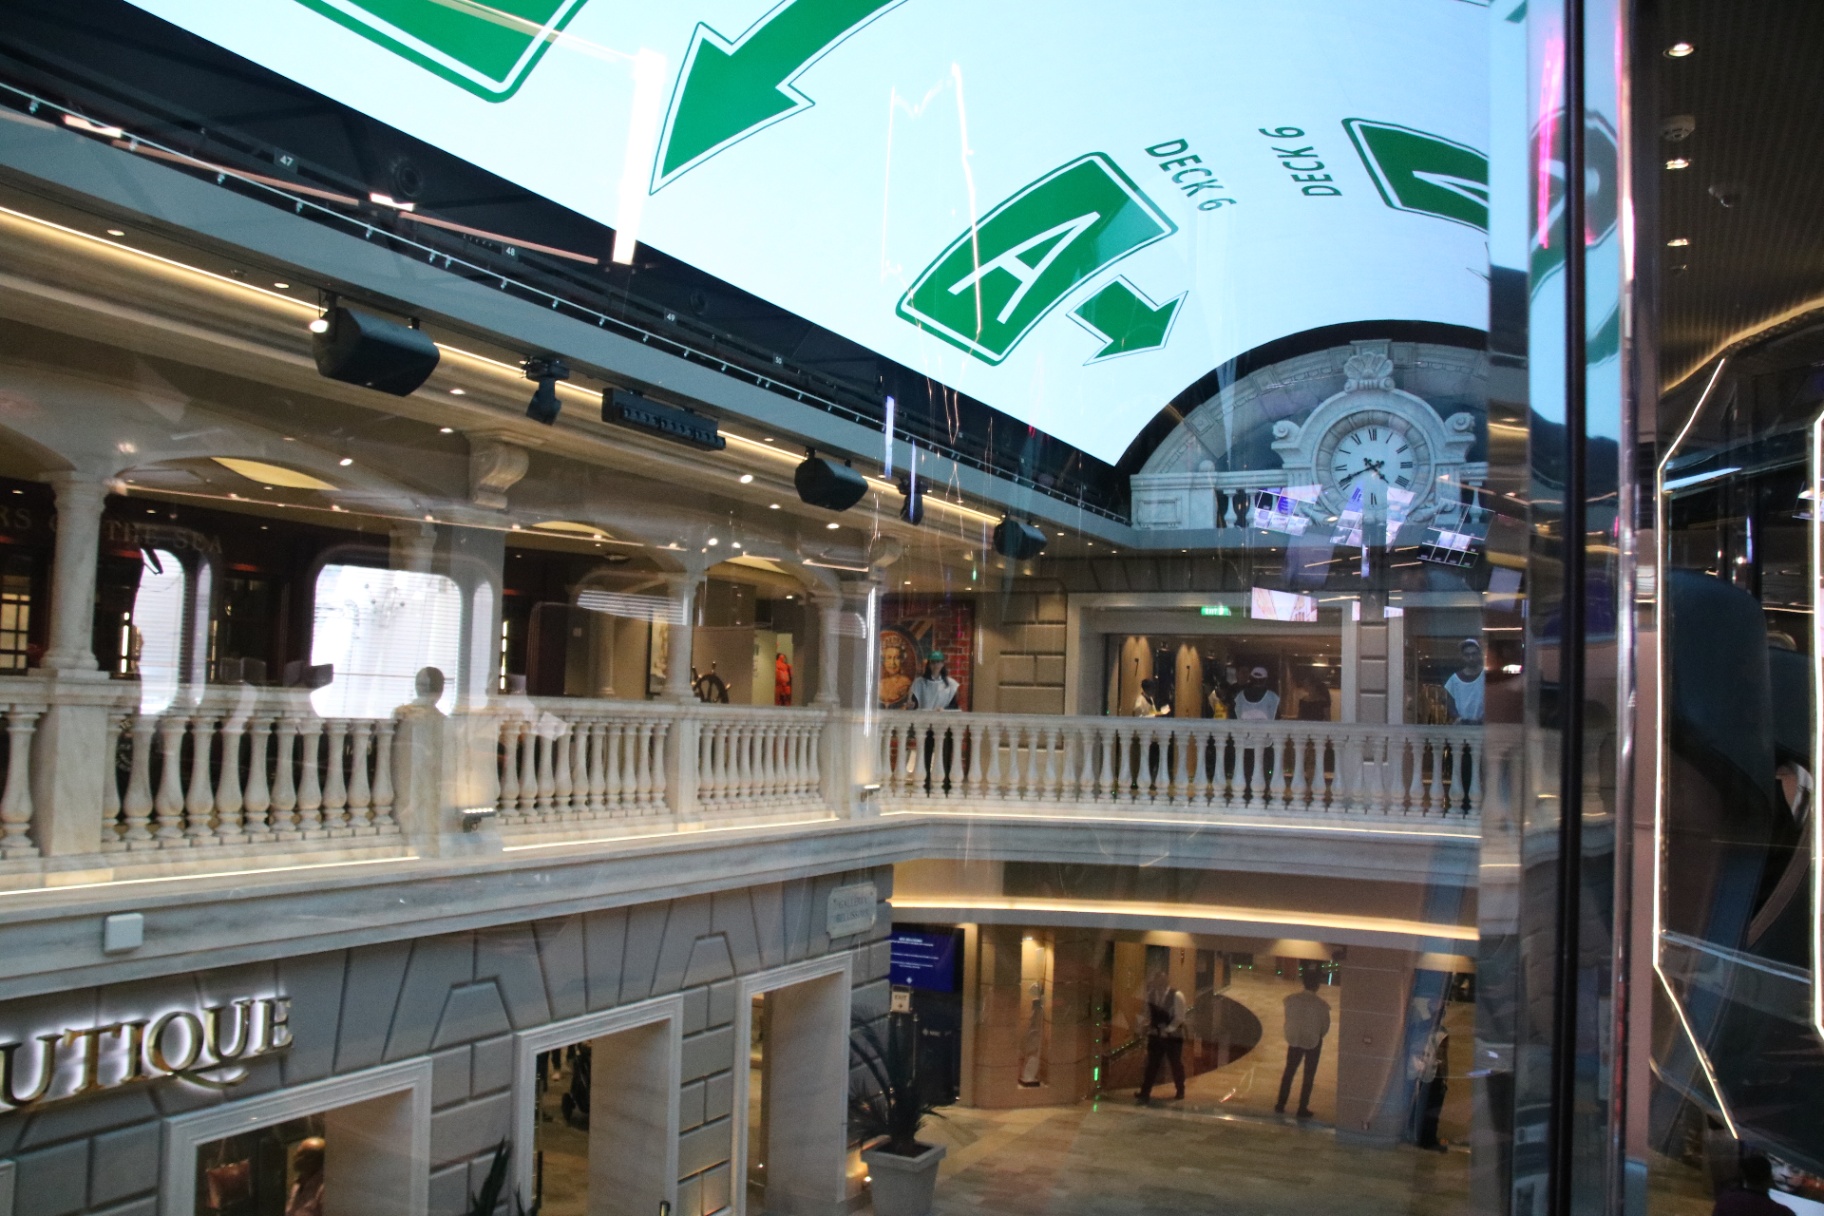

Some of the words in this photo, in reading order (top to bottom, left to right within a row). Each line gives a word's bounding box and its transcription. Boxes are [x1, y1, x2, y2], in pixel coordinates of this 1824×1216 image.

[1258, 127, 1305, 138] 6
[1144, 138, 1224, 198] DECK
[1197, 198, 1237, 211] 6
[1271, 146, 1343, 196] DECK
[505, 246, 516, 257] 48
[947, 211, 1101, 325] A
[0, 995, 294, 1107] UTIQUE
